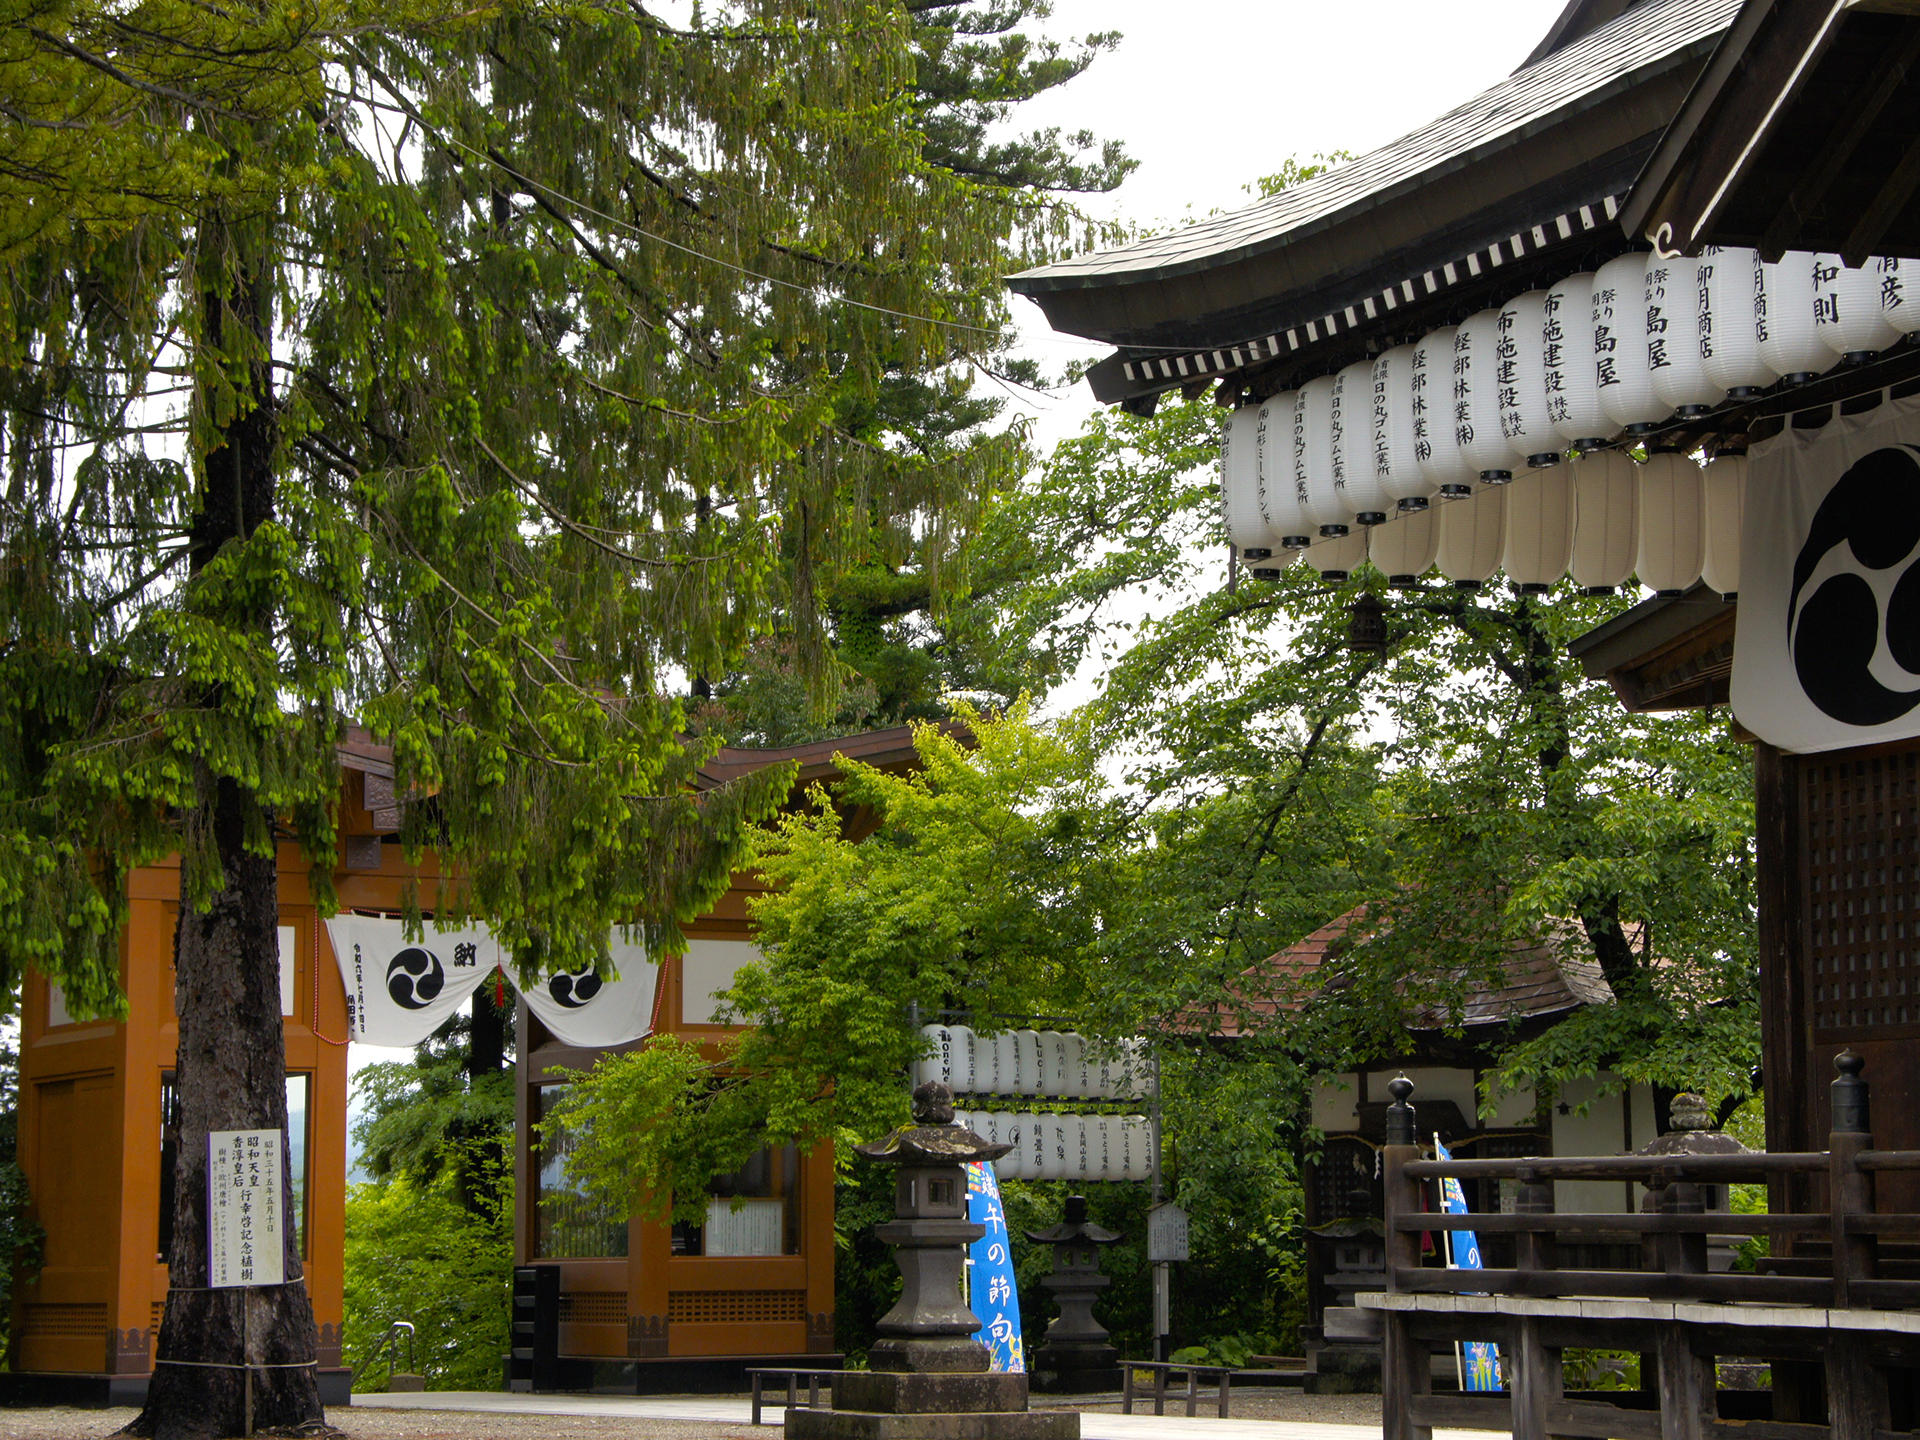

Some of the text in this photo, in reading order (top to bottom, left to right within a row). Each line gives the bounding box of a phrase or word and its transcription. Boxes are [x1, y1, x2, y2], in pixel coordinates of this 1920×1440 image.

[1697, 264, 1714, 360] 卯月商店
[1811, 252, 1840, 327] 和則
[453, 941, 477, 968] 納
[1034, 1036, 1043, 1088] Lucia
[232, 1135, 244, 1188] 香淳皇后
[247, 1136, 260, 1187] 昭和天皇
[264, 1140, 274, 1233] 昭和三十五年五月十日
[240, 1189, 253, 1281] 行幸啓記念植樹
[980, 1169, 1012, 1344] 端午の節句
